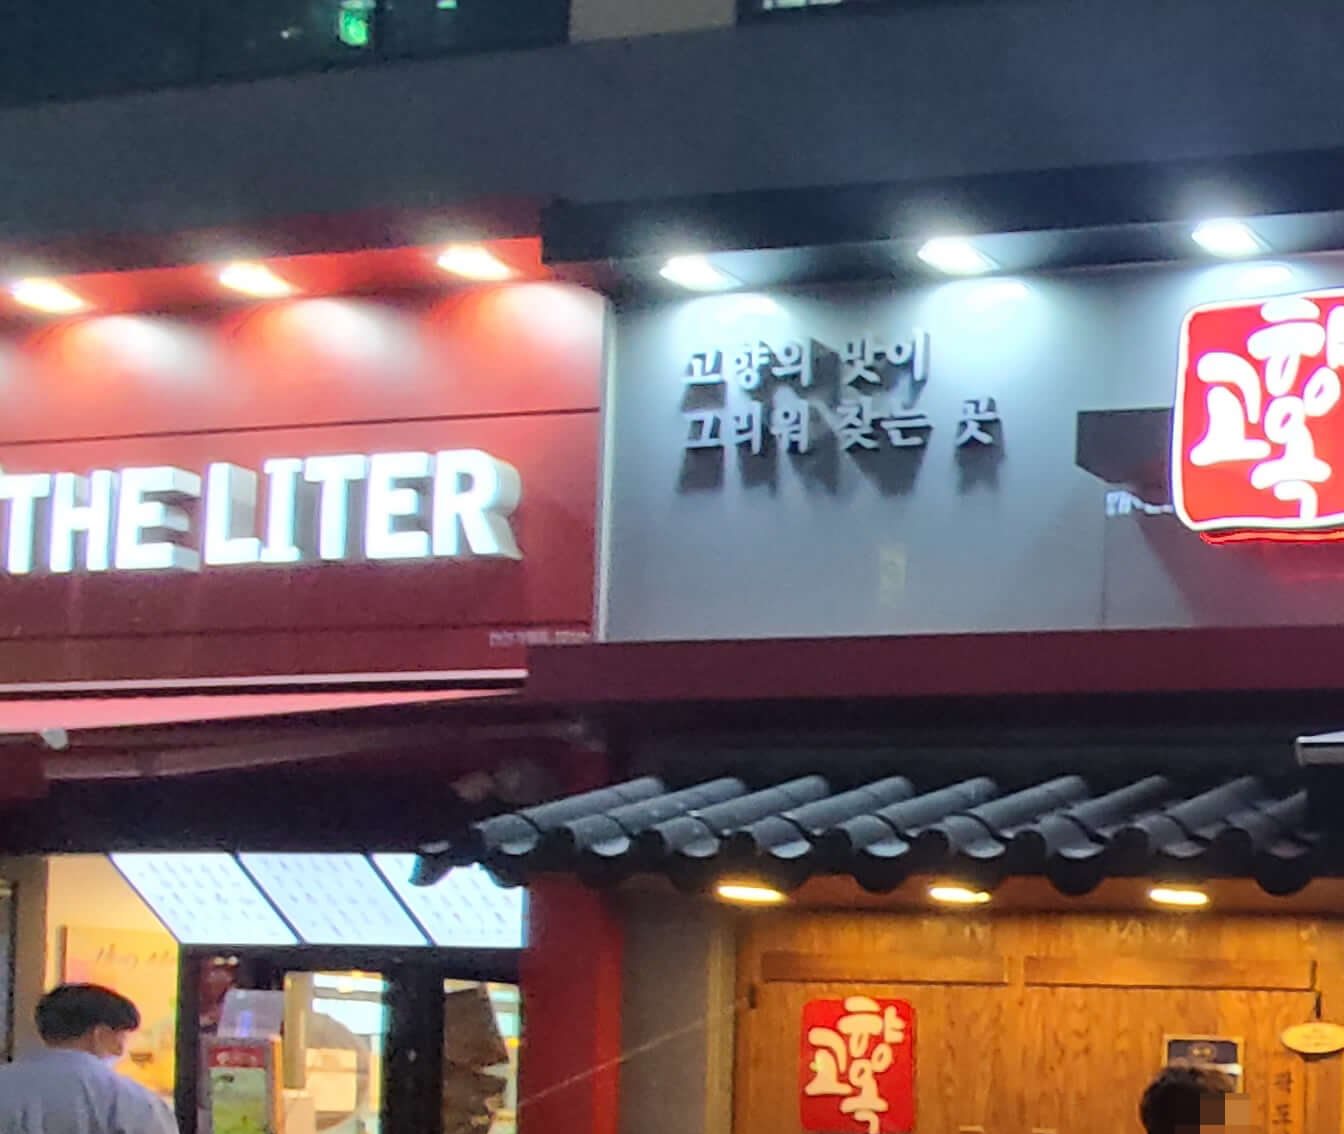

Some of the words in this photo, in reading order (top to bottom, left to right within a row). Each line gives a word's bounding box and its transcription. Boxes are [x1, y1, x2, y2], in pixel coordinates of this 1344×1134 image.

[682, 338, 813, 390] 고향의
[844, 328, 930, 385] 맛이
[682, 398, 811, 454] 그리워
[836, 399, 934, 451] 찾는
[954, 397, 1001, 447] 곳
[0, 466, 192, 574] THE
[204, 449, 519, 565] LITER
